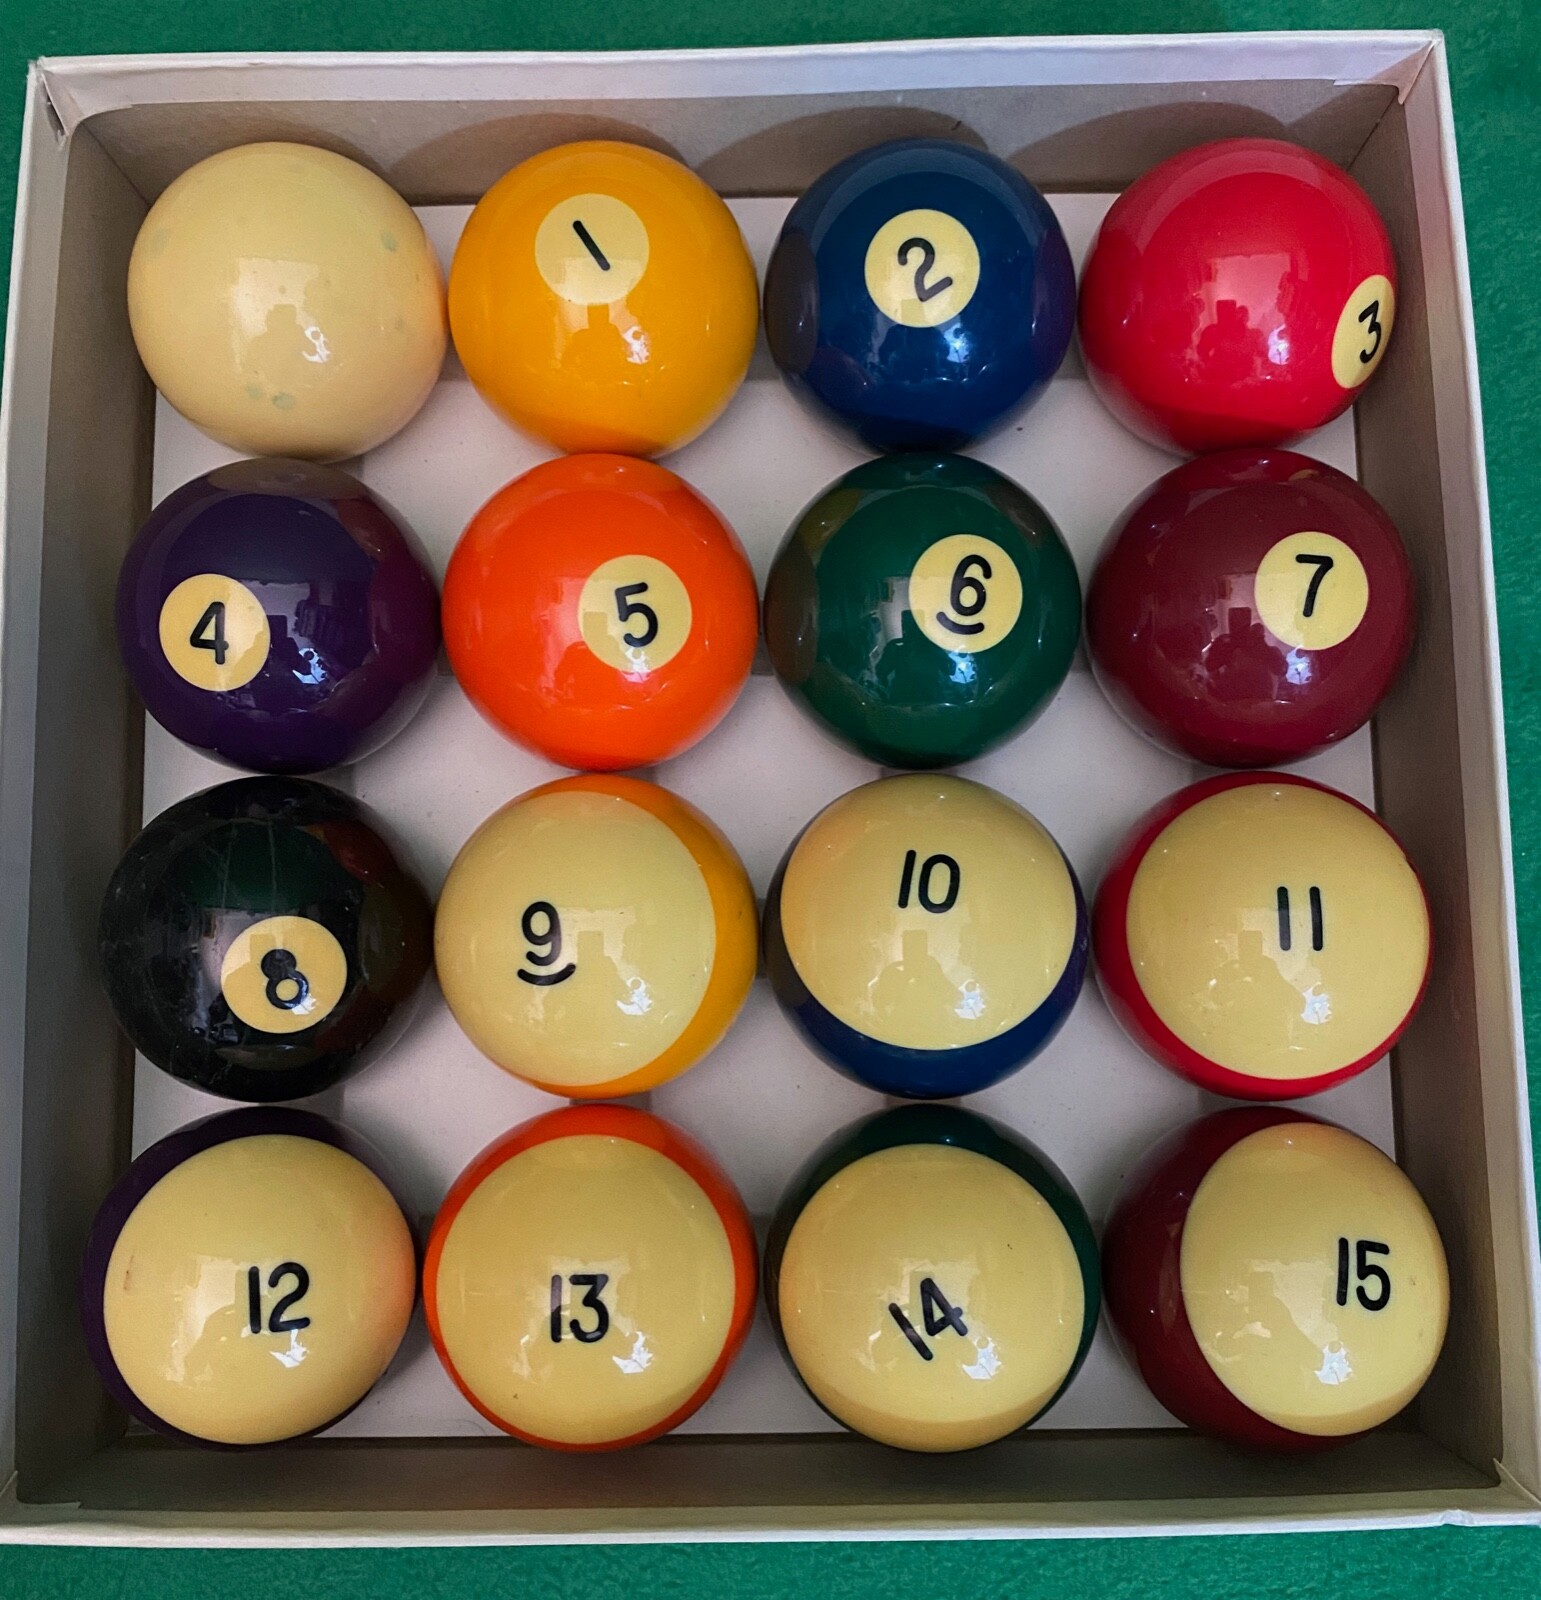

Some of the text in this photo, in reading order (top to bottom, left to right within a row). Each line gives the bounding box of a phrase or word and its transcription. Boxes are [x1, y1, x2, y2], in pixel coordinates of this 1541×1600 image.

[573, 221, 610, 270] 1
[898, 238, 952, 302] 2
[1358, 299, 1382, 363] 3
[615, 582, 658, 647] 5
[936, 553, 991, 636] 6
[1295, 553, 1334, 618] 7
[190, 602, 228, 664] 4
[898, 850, 960, 913] 10
[517, 901, 576, 986] 9
[1277, 886, 1323, 951] 11
[260, 948, 309, 1011] 8
[248, 1262, 310, 1334] 12
[1336, 1237, 1390, 1311] 15
[550, 1273, 610, 1344] 13
[889, 1278, 968, 1361] 14
